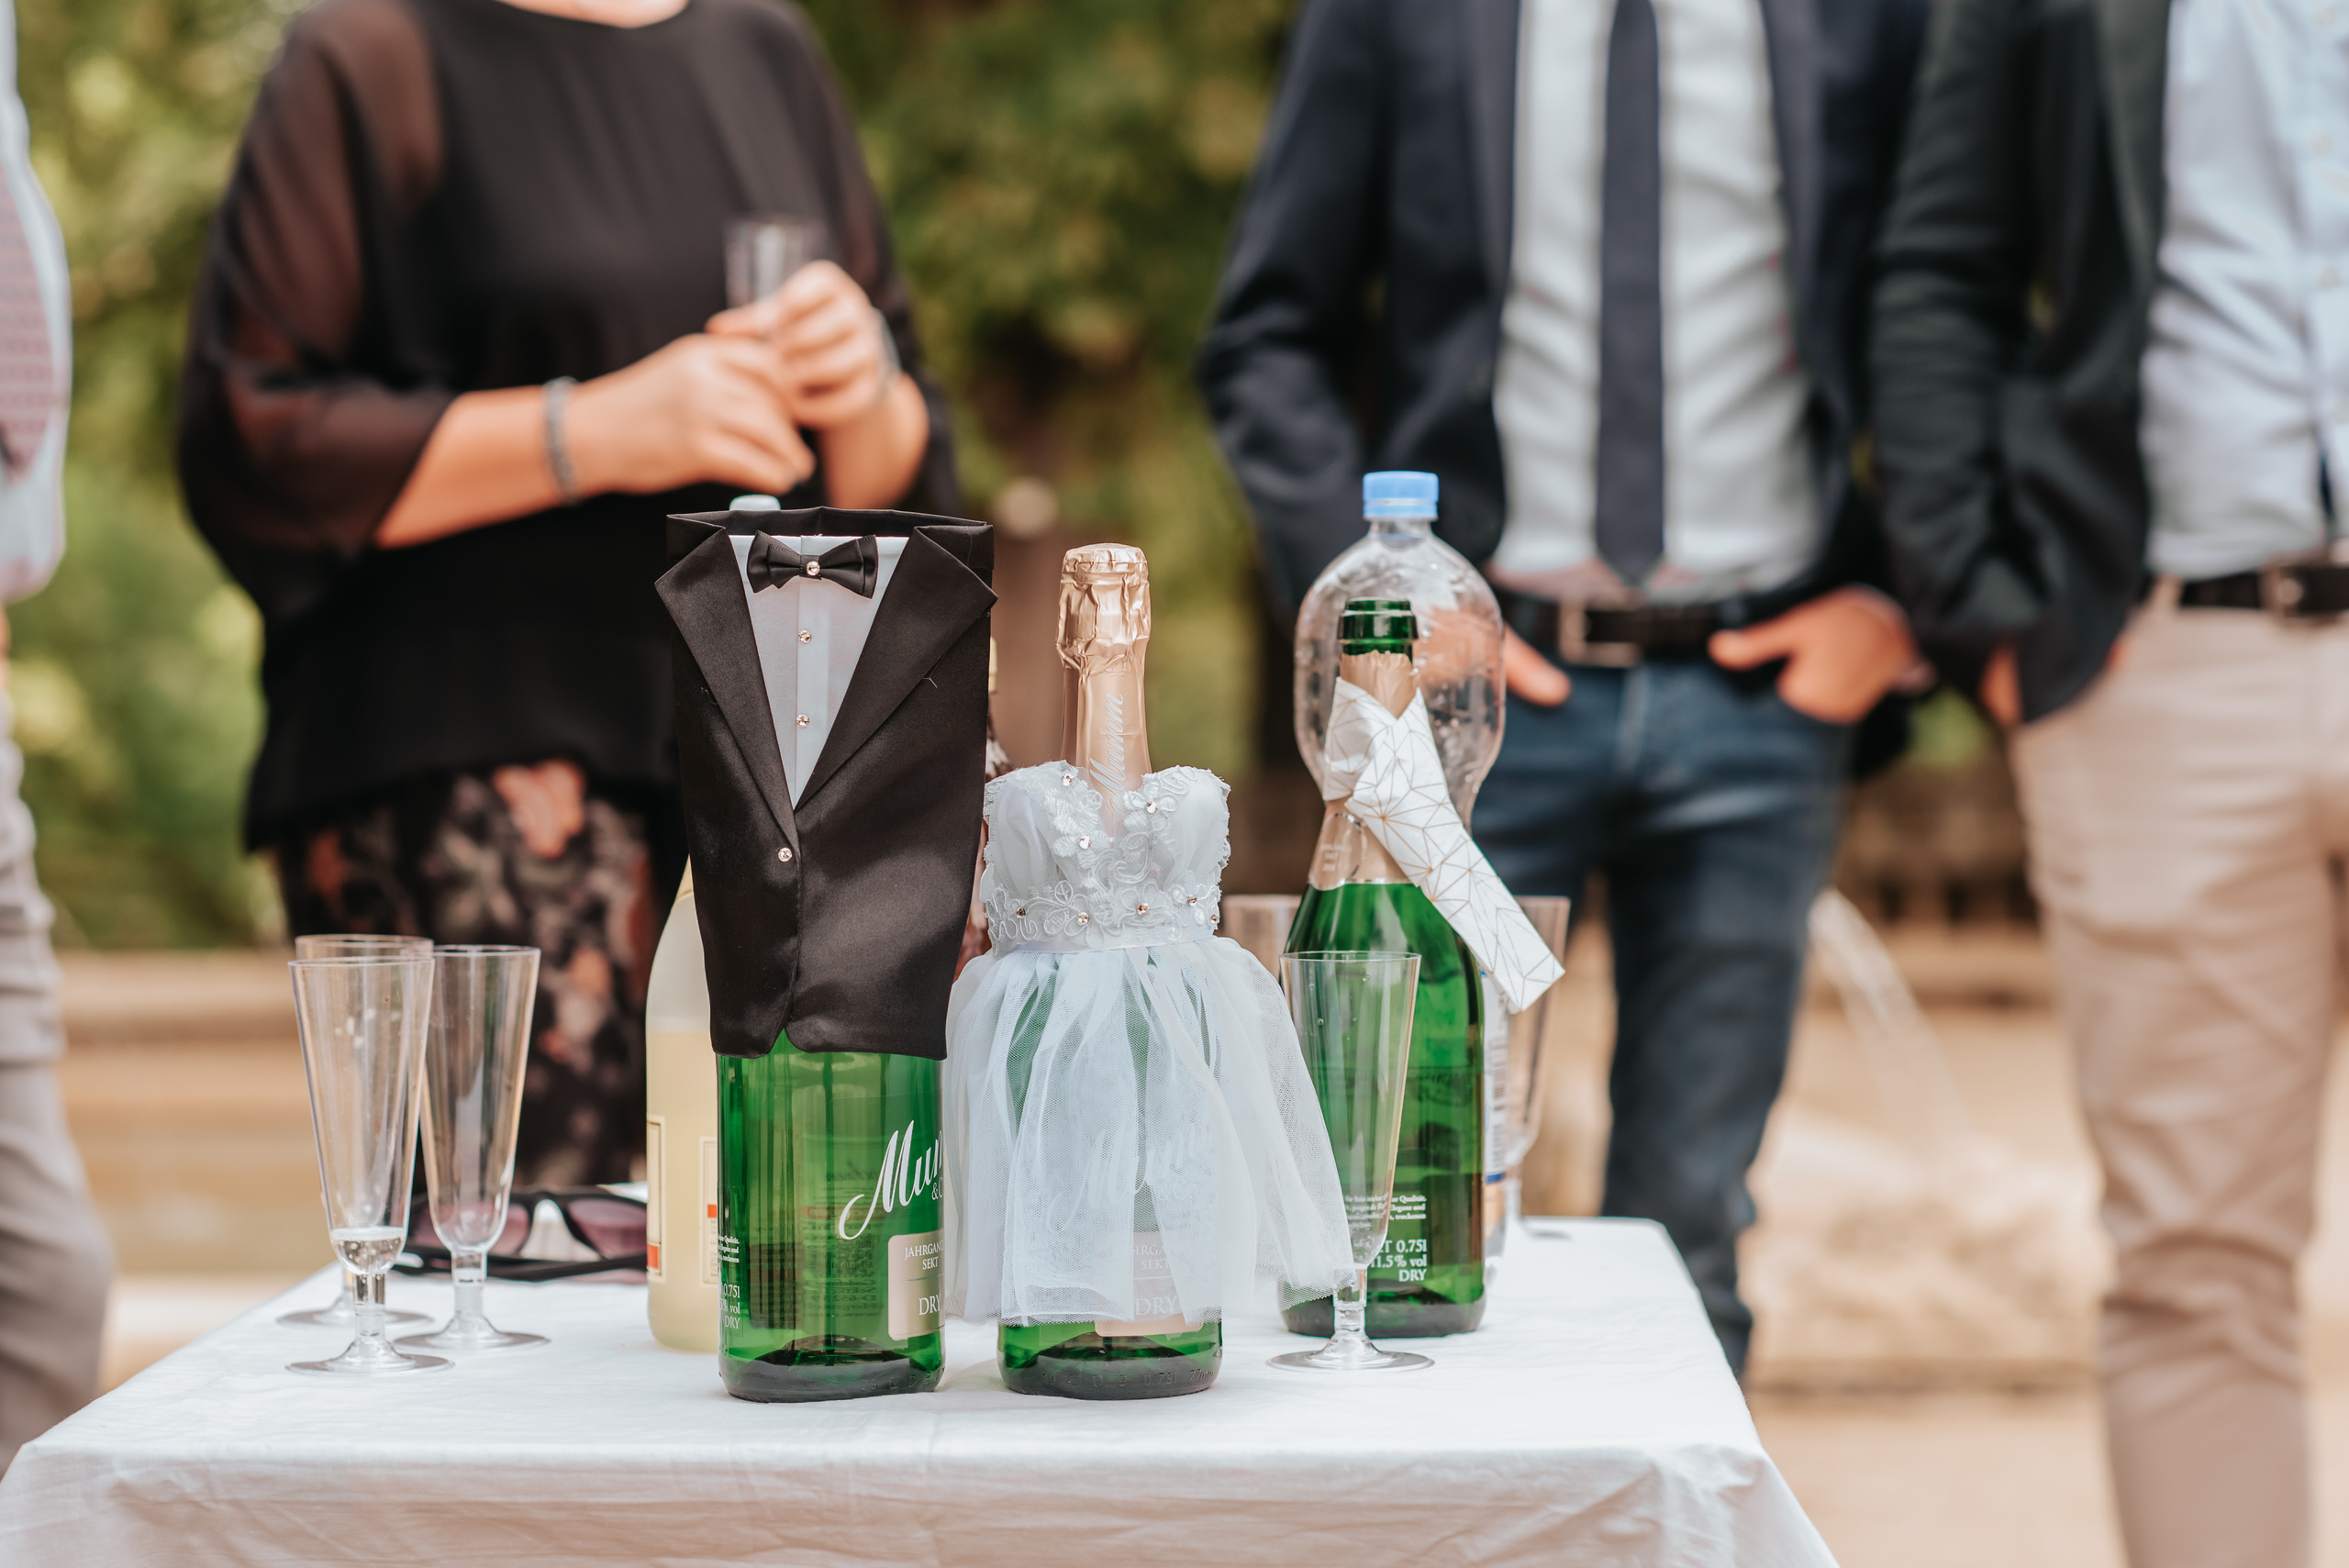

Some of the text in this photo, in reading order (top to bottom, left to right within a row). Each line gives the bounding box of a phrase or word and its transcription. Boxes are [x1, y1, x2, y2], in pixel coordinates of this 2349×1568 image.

[922, 1256, 939, 1270] SEKT
[1409, 1253, 1427, 1267] vol
[1398, 1269, 1427, 1283] DRY
[729, 1301, 740, 1314] vol
[918, 1293, 941, 1316] DRY
[1135, 1296, 1177, 1316] DRY
[724, 1315, 740, 1329] DRY
